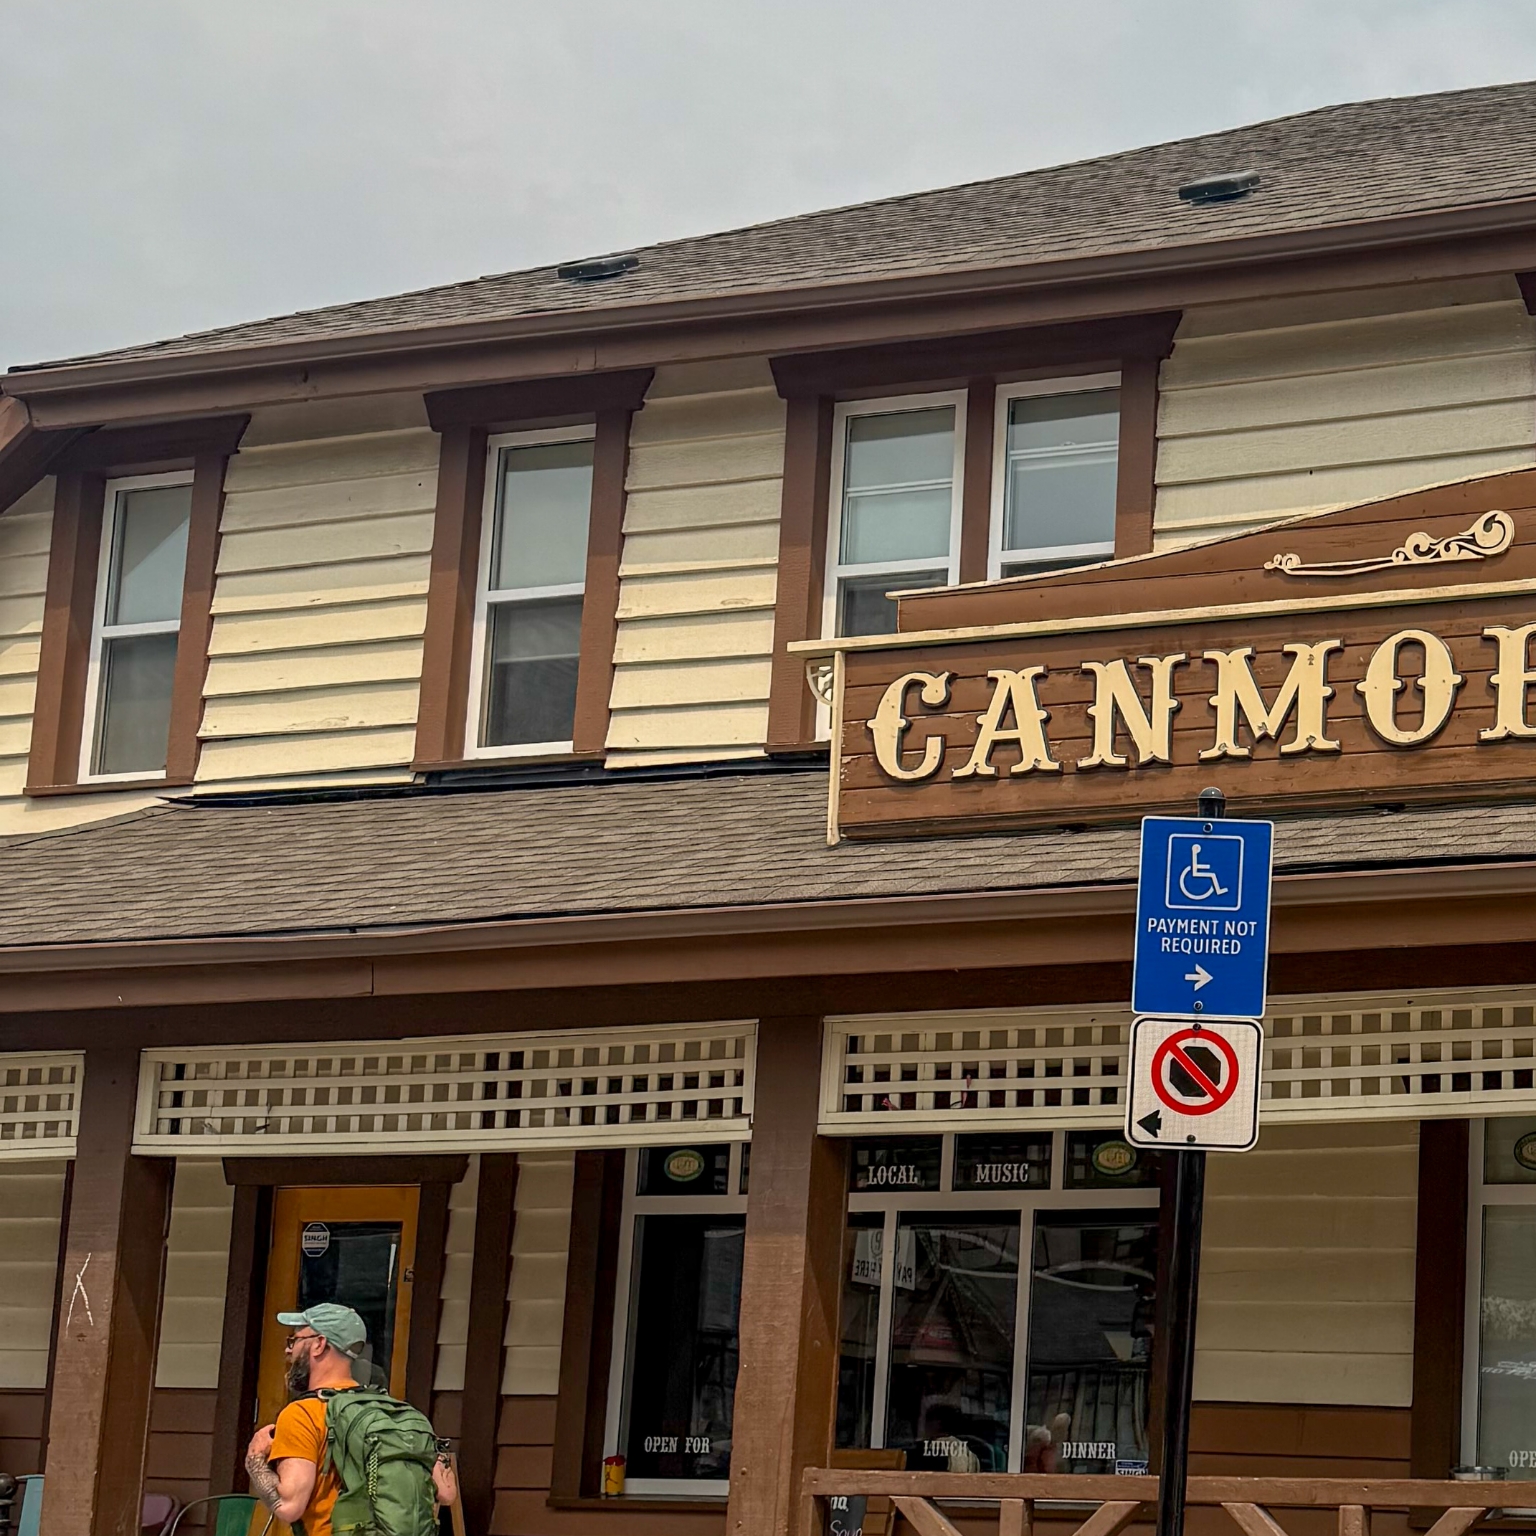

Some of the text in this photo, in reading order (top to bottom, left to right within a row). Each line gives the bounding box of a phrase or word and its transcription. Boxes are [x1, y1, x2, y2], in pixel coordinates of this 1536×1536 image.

[1147, 917, 1257, 937] PAYMENT NOT
[1161, 937, 1242, 955] REQUIRED
[867, 1165, 918, 1185] LOCAL
[975, 1163, 1029, 1183] MUSIC
[644, 1436, 710, 1453] OPEN FOR
[923, 1440, 969, 1457] LUNCH
[1062, 1442, 1116, 1459] DINNER
